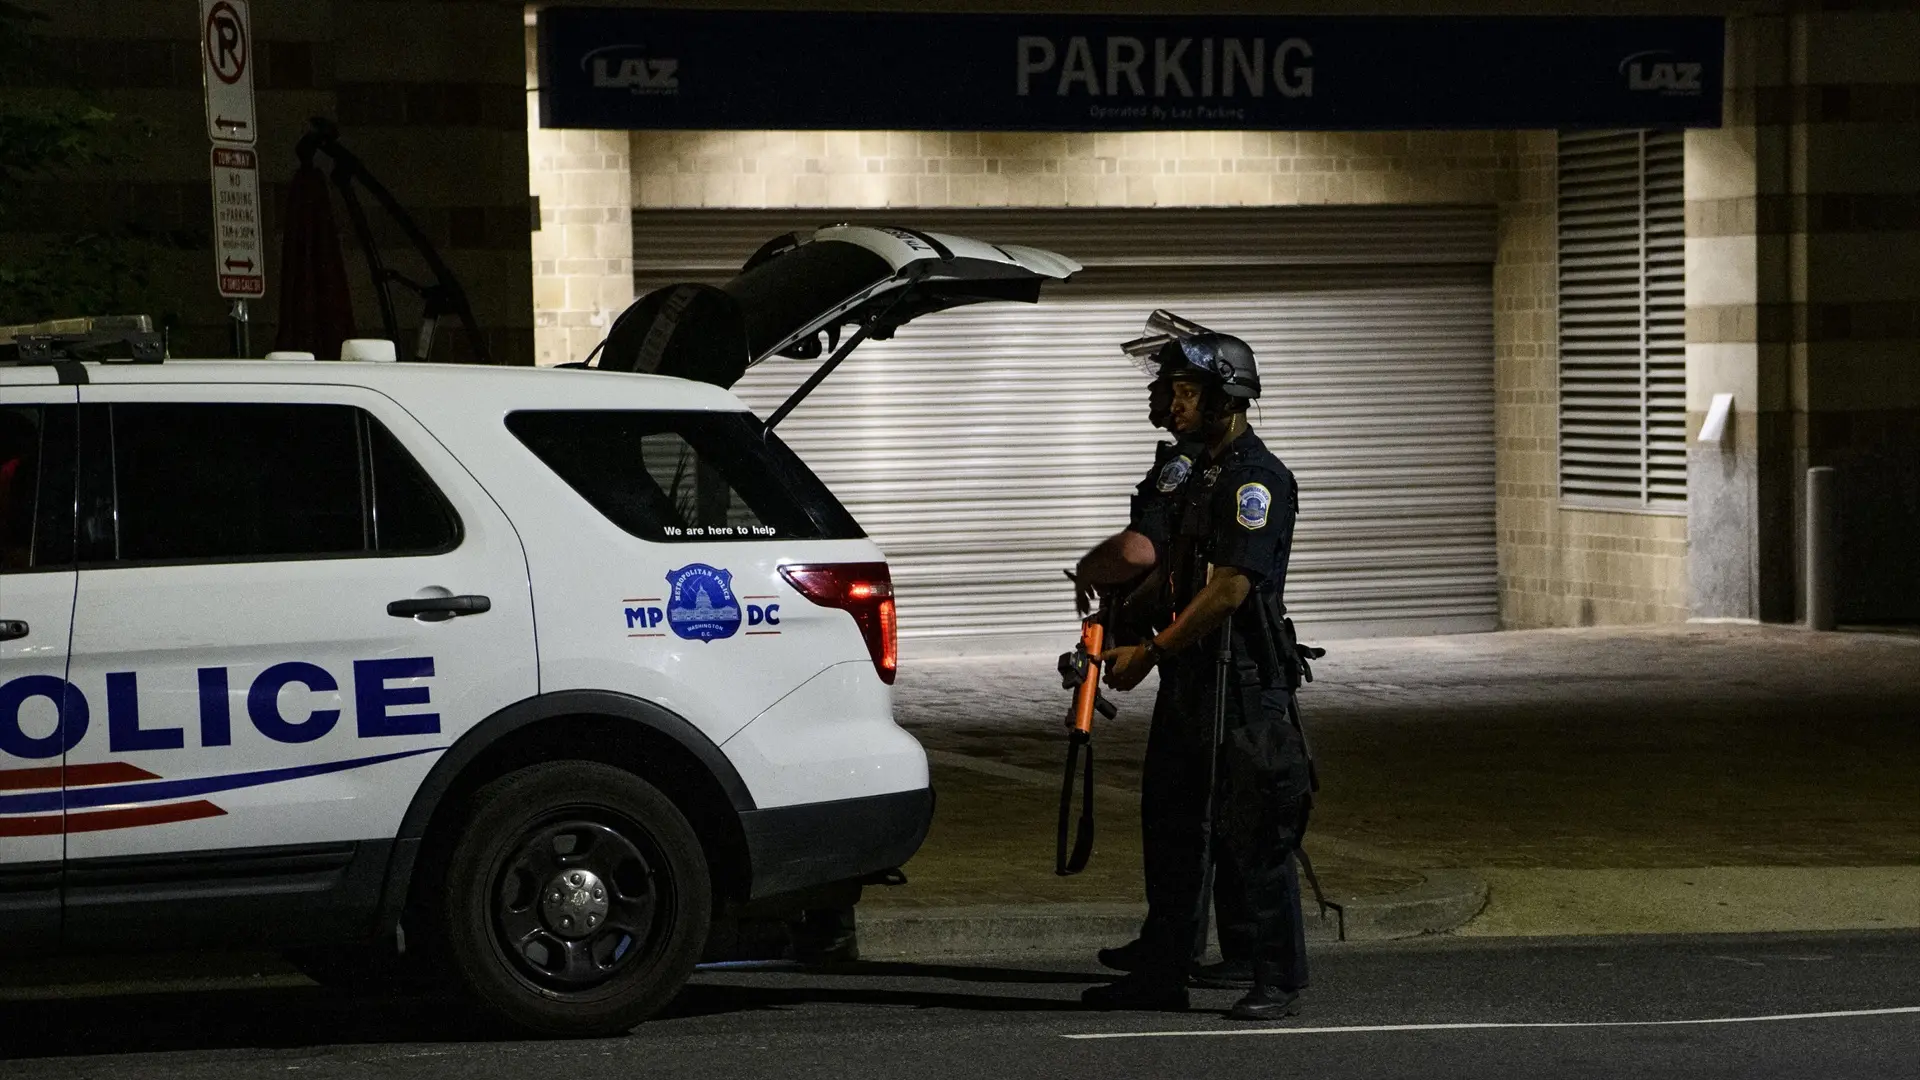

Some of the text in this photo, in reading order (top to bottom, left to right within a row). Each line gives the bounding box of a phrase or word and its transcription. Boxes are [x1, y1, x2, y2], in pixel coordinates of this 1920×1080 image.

[592, 57, 680, 88] LAZ
[1016, 35, 1315, 99] PARKING
[1628, 61, 1703, 92] LAZ
[1088, 104, 1245, 121] Operated By Laz Parking
[229, 173, 241, 188] NO
[219, 191, 252, 206] STANDING
[226, 208, 254, 223] PARKING
[664, 525, 776, 537] We are here to help
[675, 568, 731, 601] METROPOLITAN POLICE
[624, 607, 664, 629] MP
[746, 604, 780, 626] DC
[687, 623, 724, 632] WASHINGTON
[0, 656, 442, 759] OLICE
